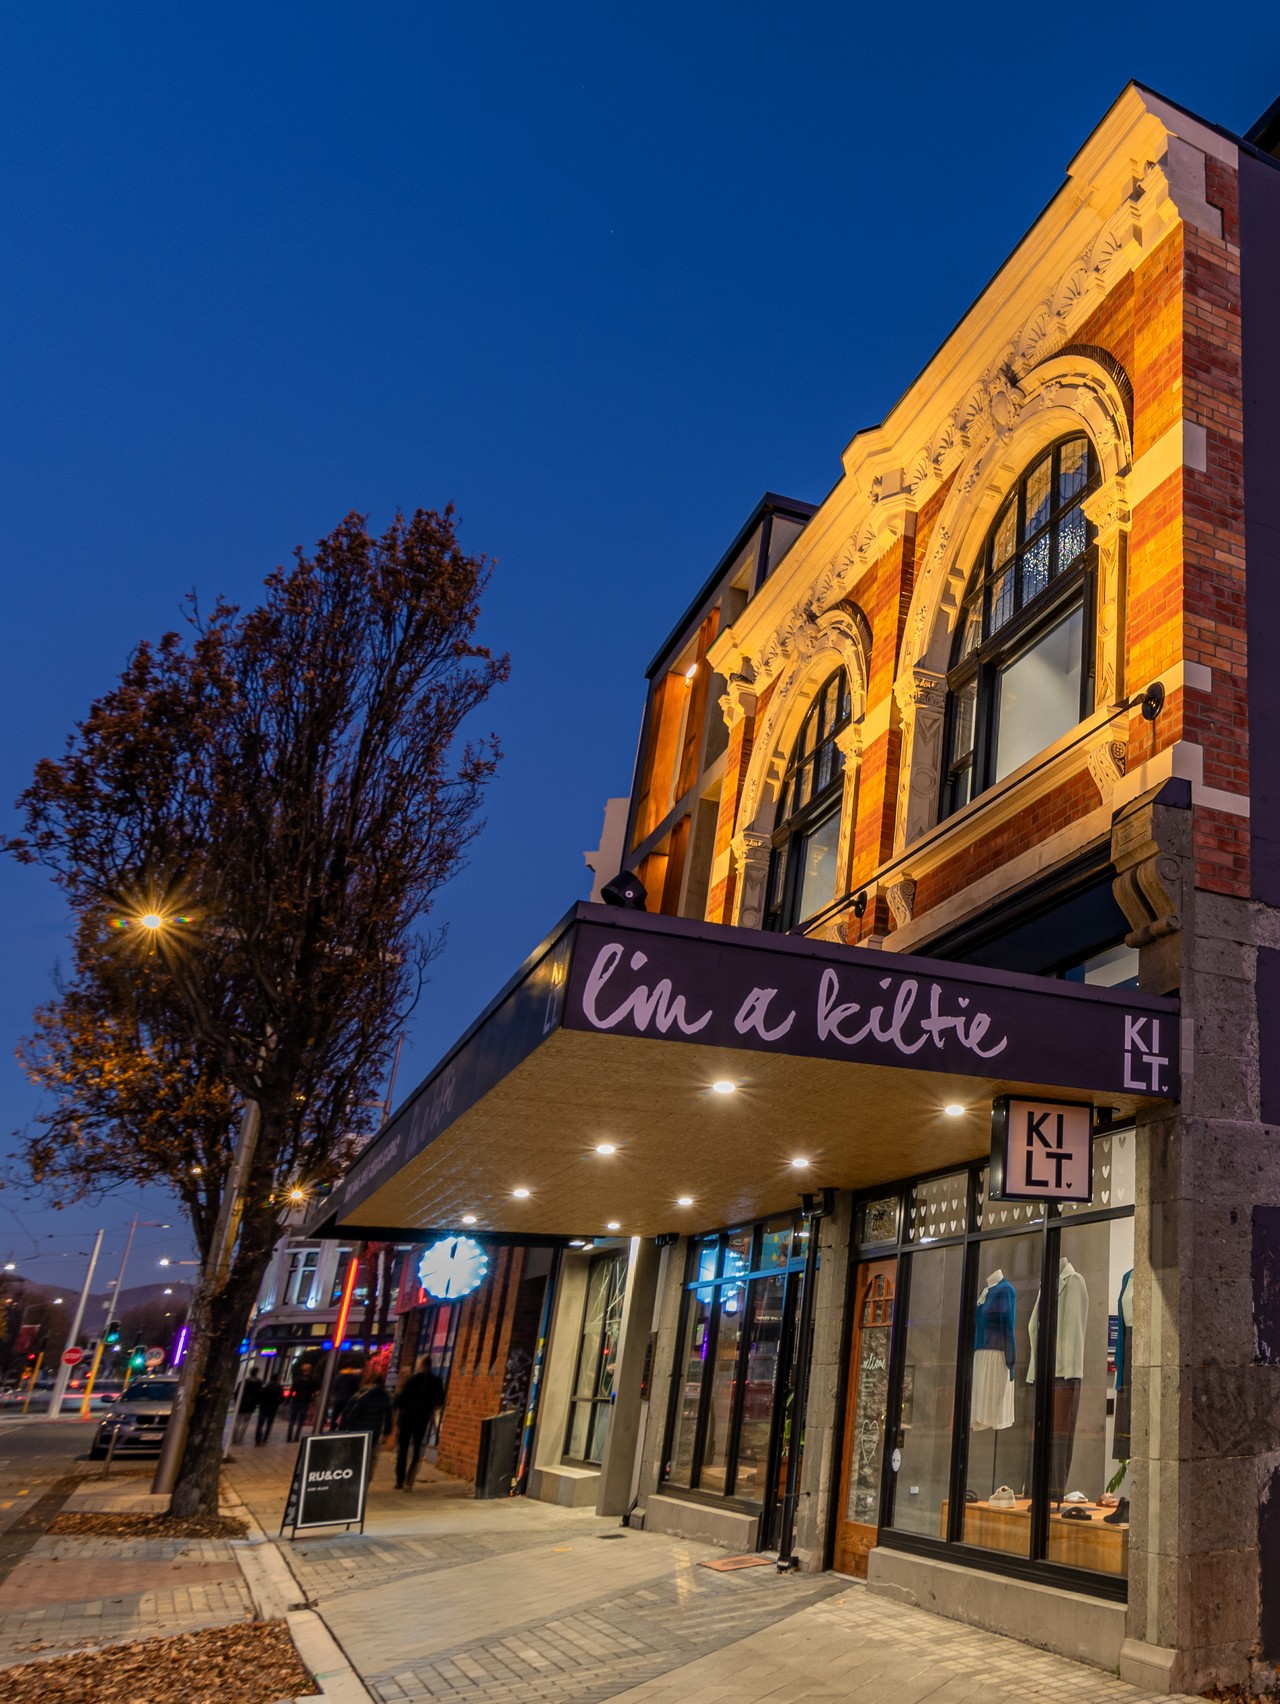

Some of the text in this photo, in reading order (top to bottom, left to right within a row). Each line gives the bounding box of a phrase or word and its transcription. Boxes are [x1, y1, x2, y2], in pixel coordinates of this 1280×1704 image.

[734, 987, 795, 1042] a
[816, 967, 1007, 1059] kiltie
[1123, 1015, 1160, 1055] KI
[1026, 1110, 1064, 1151] KI
[307, 1468, 354, 1482] RU&CO
